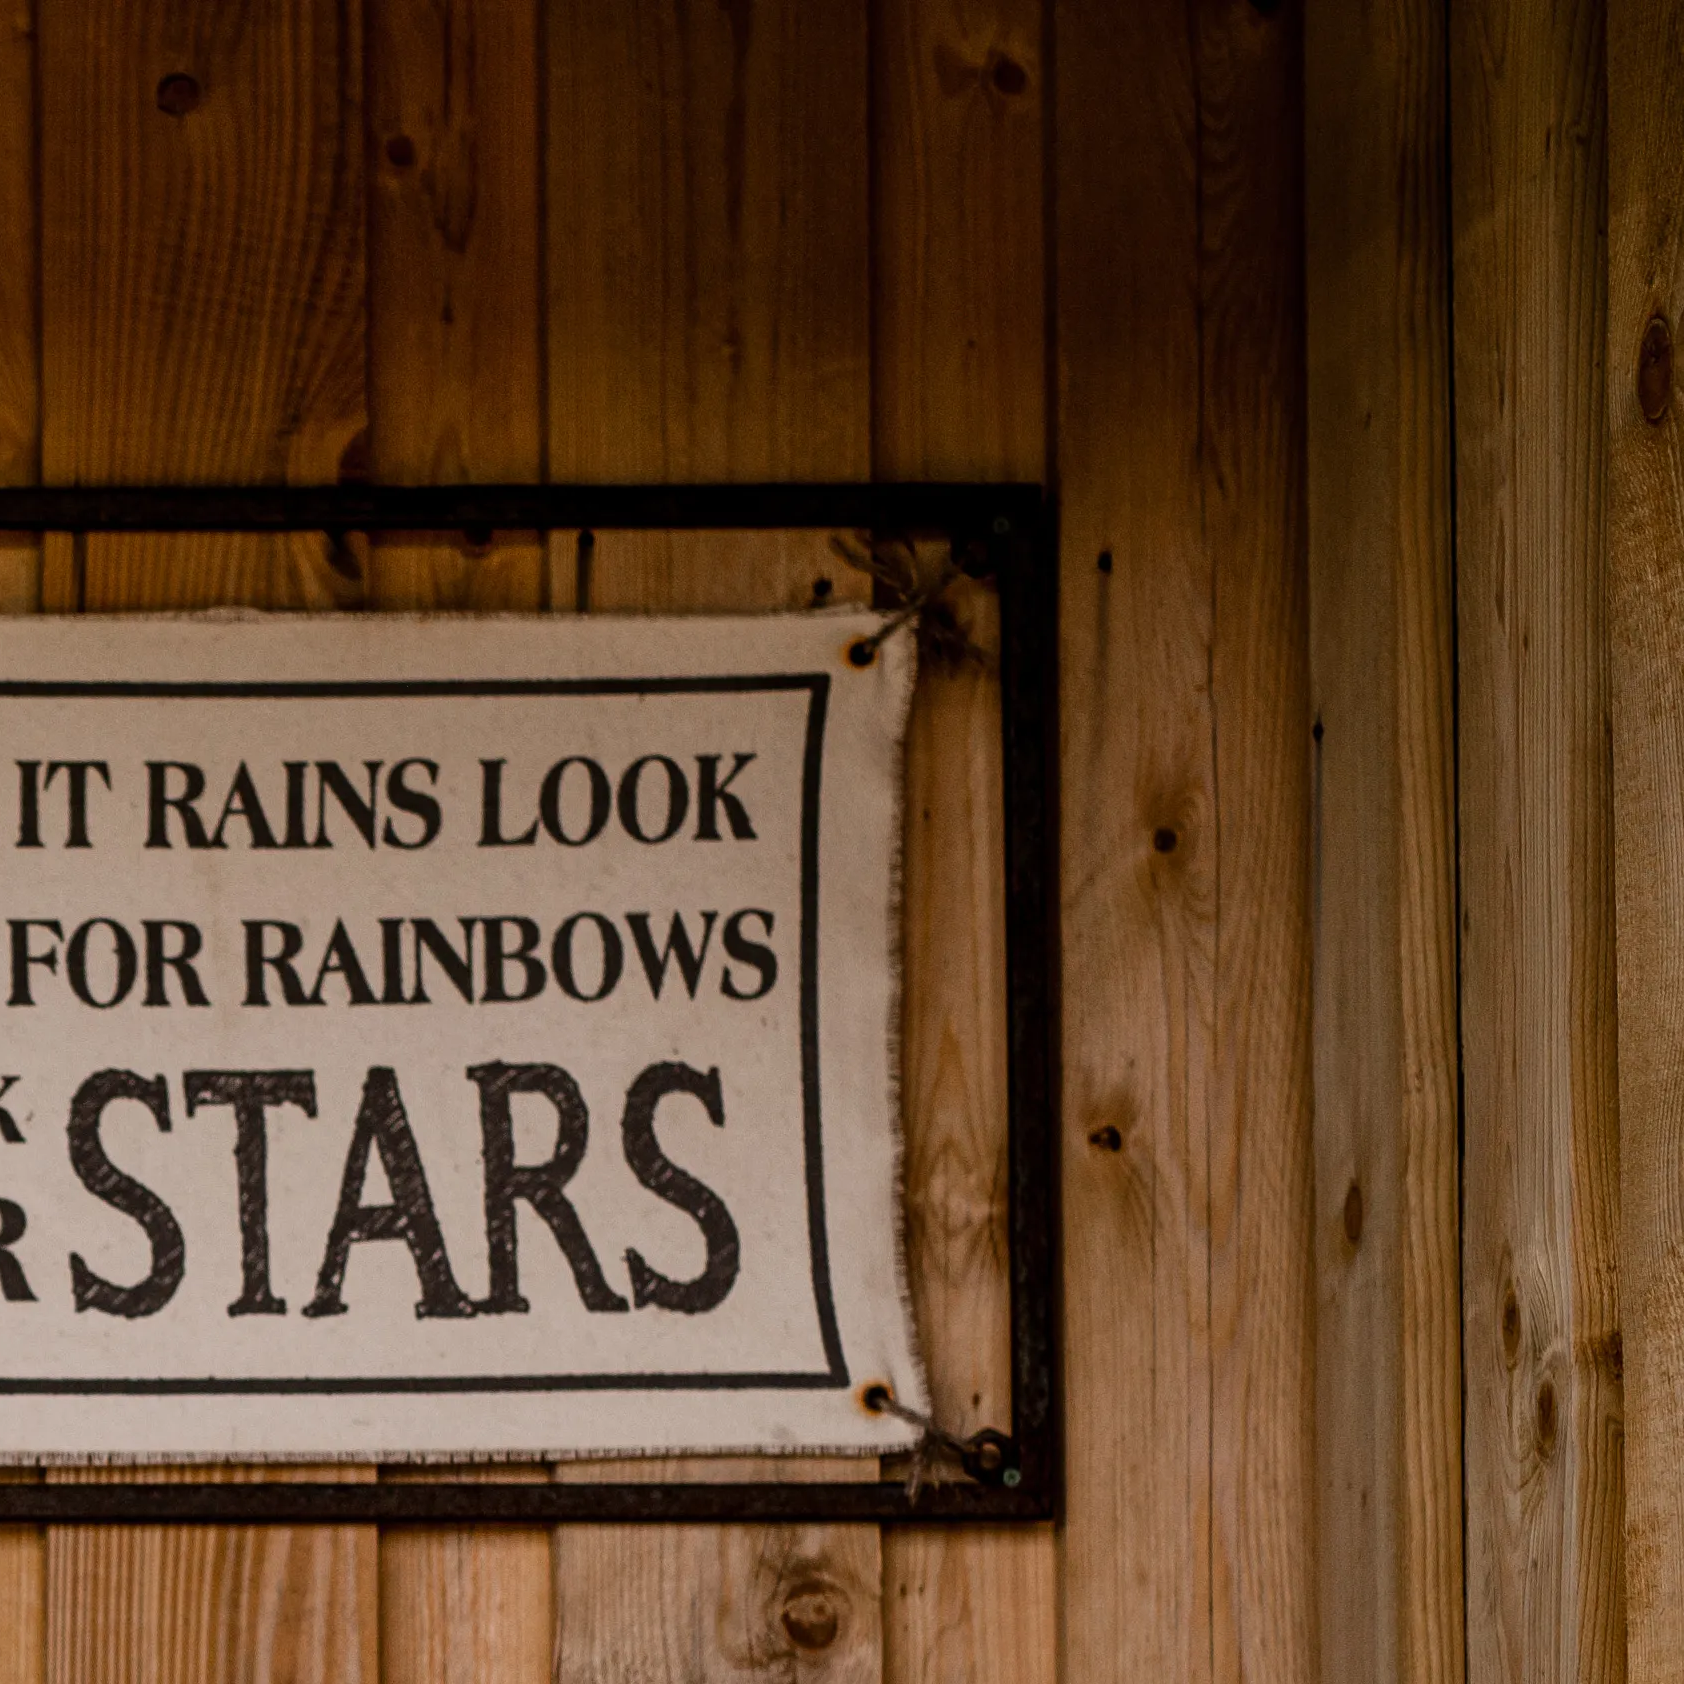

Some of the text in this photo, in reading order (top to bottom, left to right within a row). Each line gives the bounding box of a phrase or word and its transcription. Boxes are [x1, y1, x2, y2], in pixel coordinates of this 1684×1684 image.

[15, 752, 758, 851] IT RAINS LOOK
[6, 907, 778, 1007] FOR RAINBOWS
[66, 1059, 740, 1320] STARS
